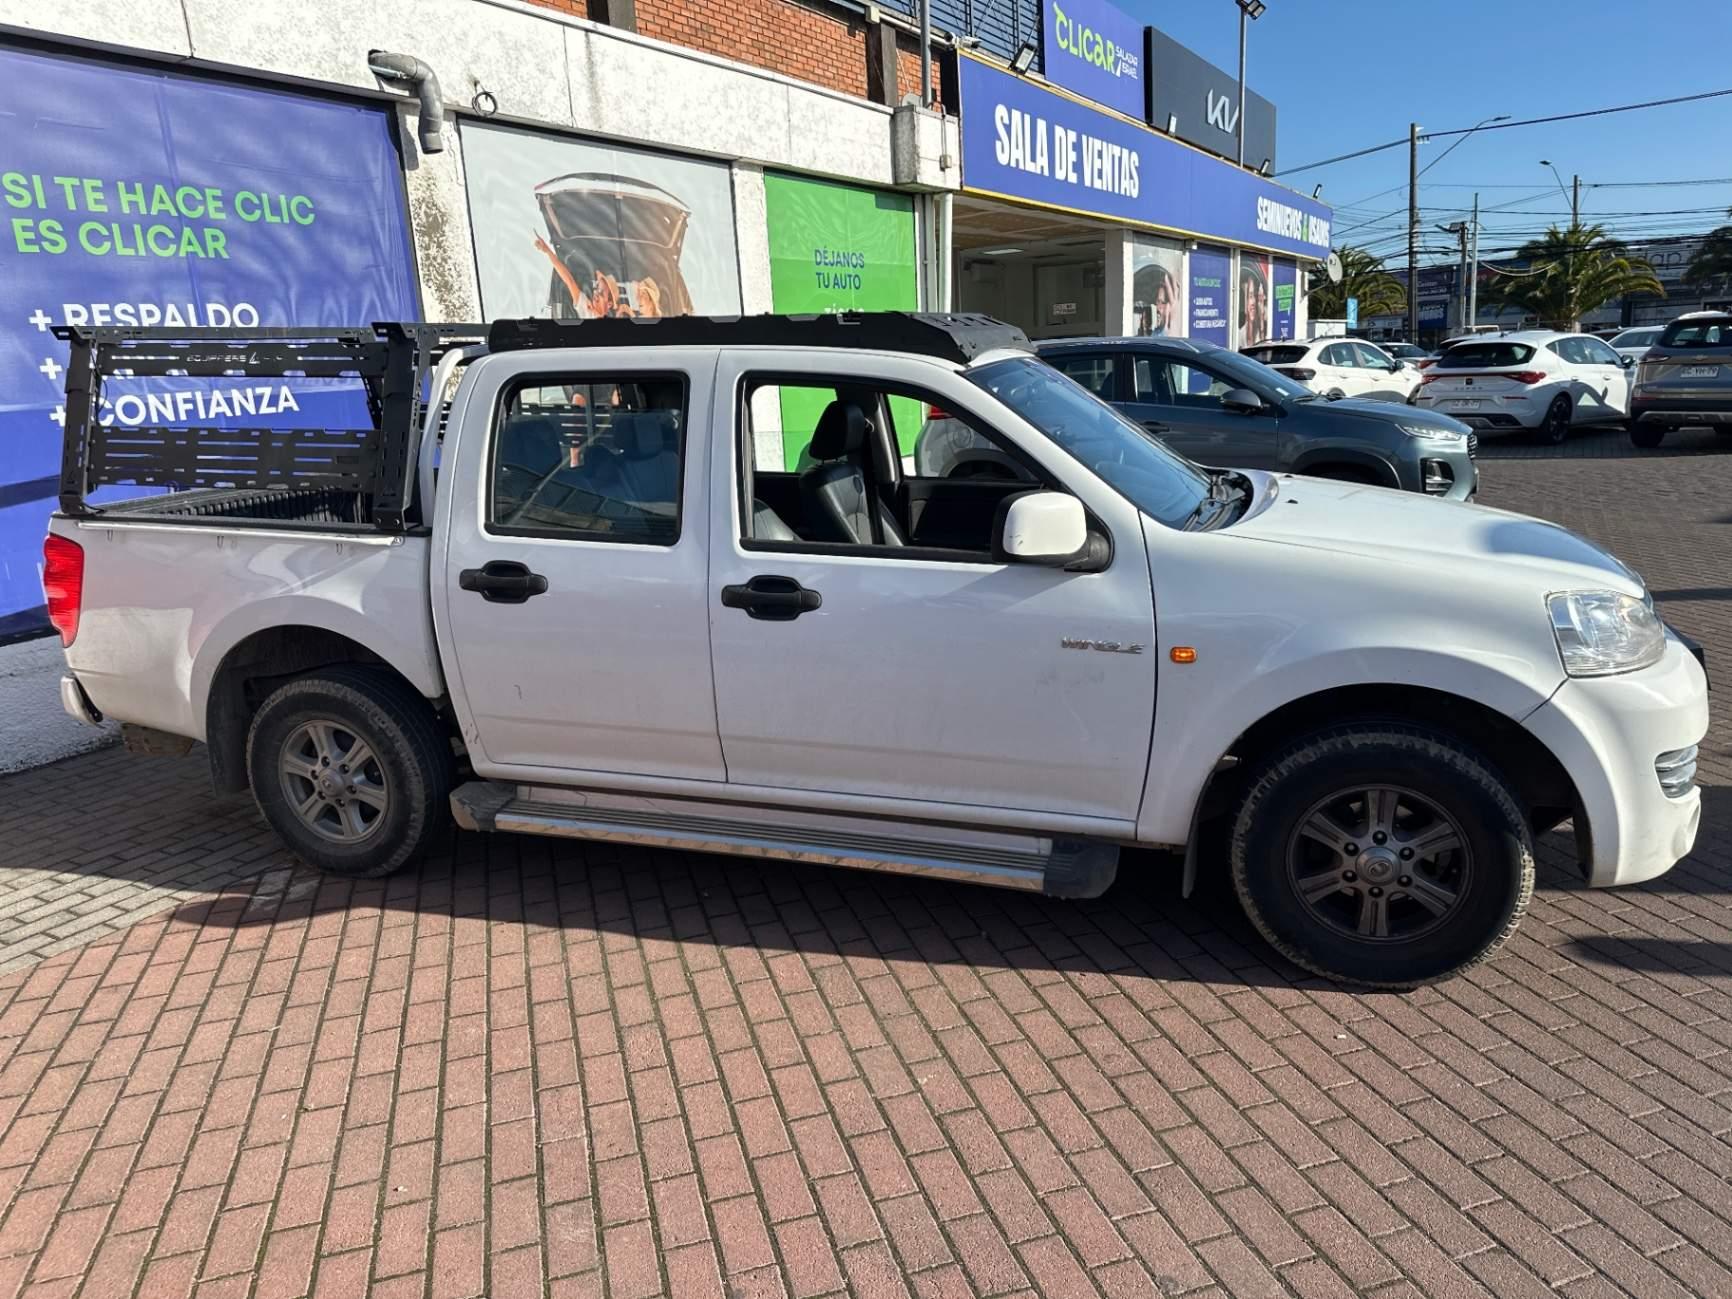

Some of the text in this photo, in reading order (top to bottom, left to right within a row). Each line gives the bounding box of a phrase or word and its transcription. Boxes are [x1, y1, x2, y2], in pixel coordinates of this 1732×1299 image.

[994, 103, 1139, 199] SALA DE VENTAS
[2, 171, 316, 225] SI TE HACE CLIC
[1257, 195, 1303, 241] SEMINUEVOS
[11, 218, 230, 259] ES CLICAR
[814, 245, 865, 269] DÉJANOS
[815, 272, 861, 290] TU AUTO
[98, 386, 300, 427] CONFIANZA
